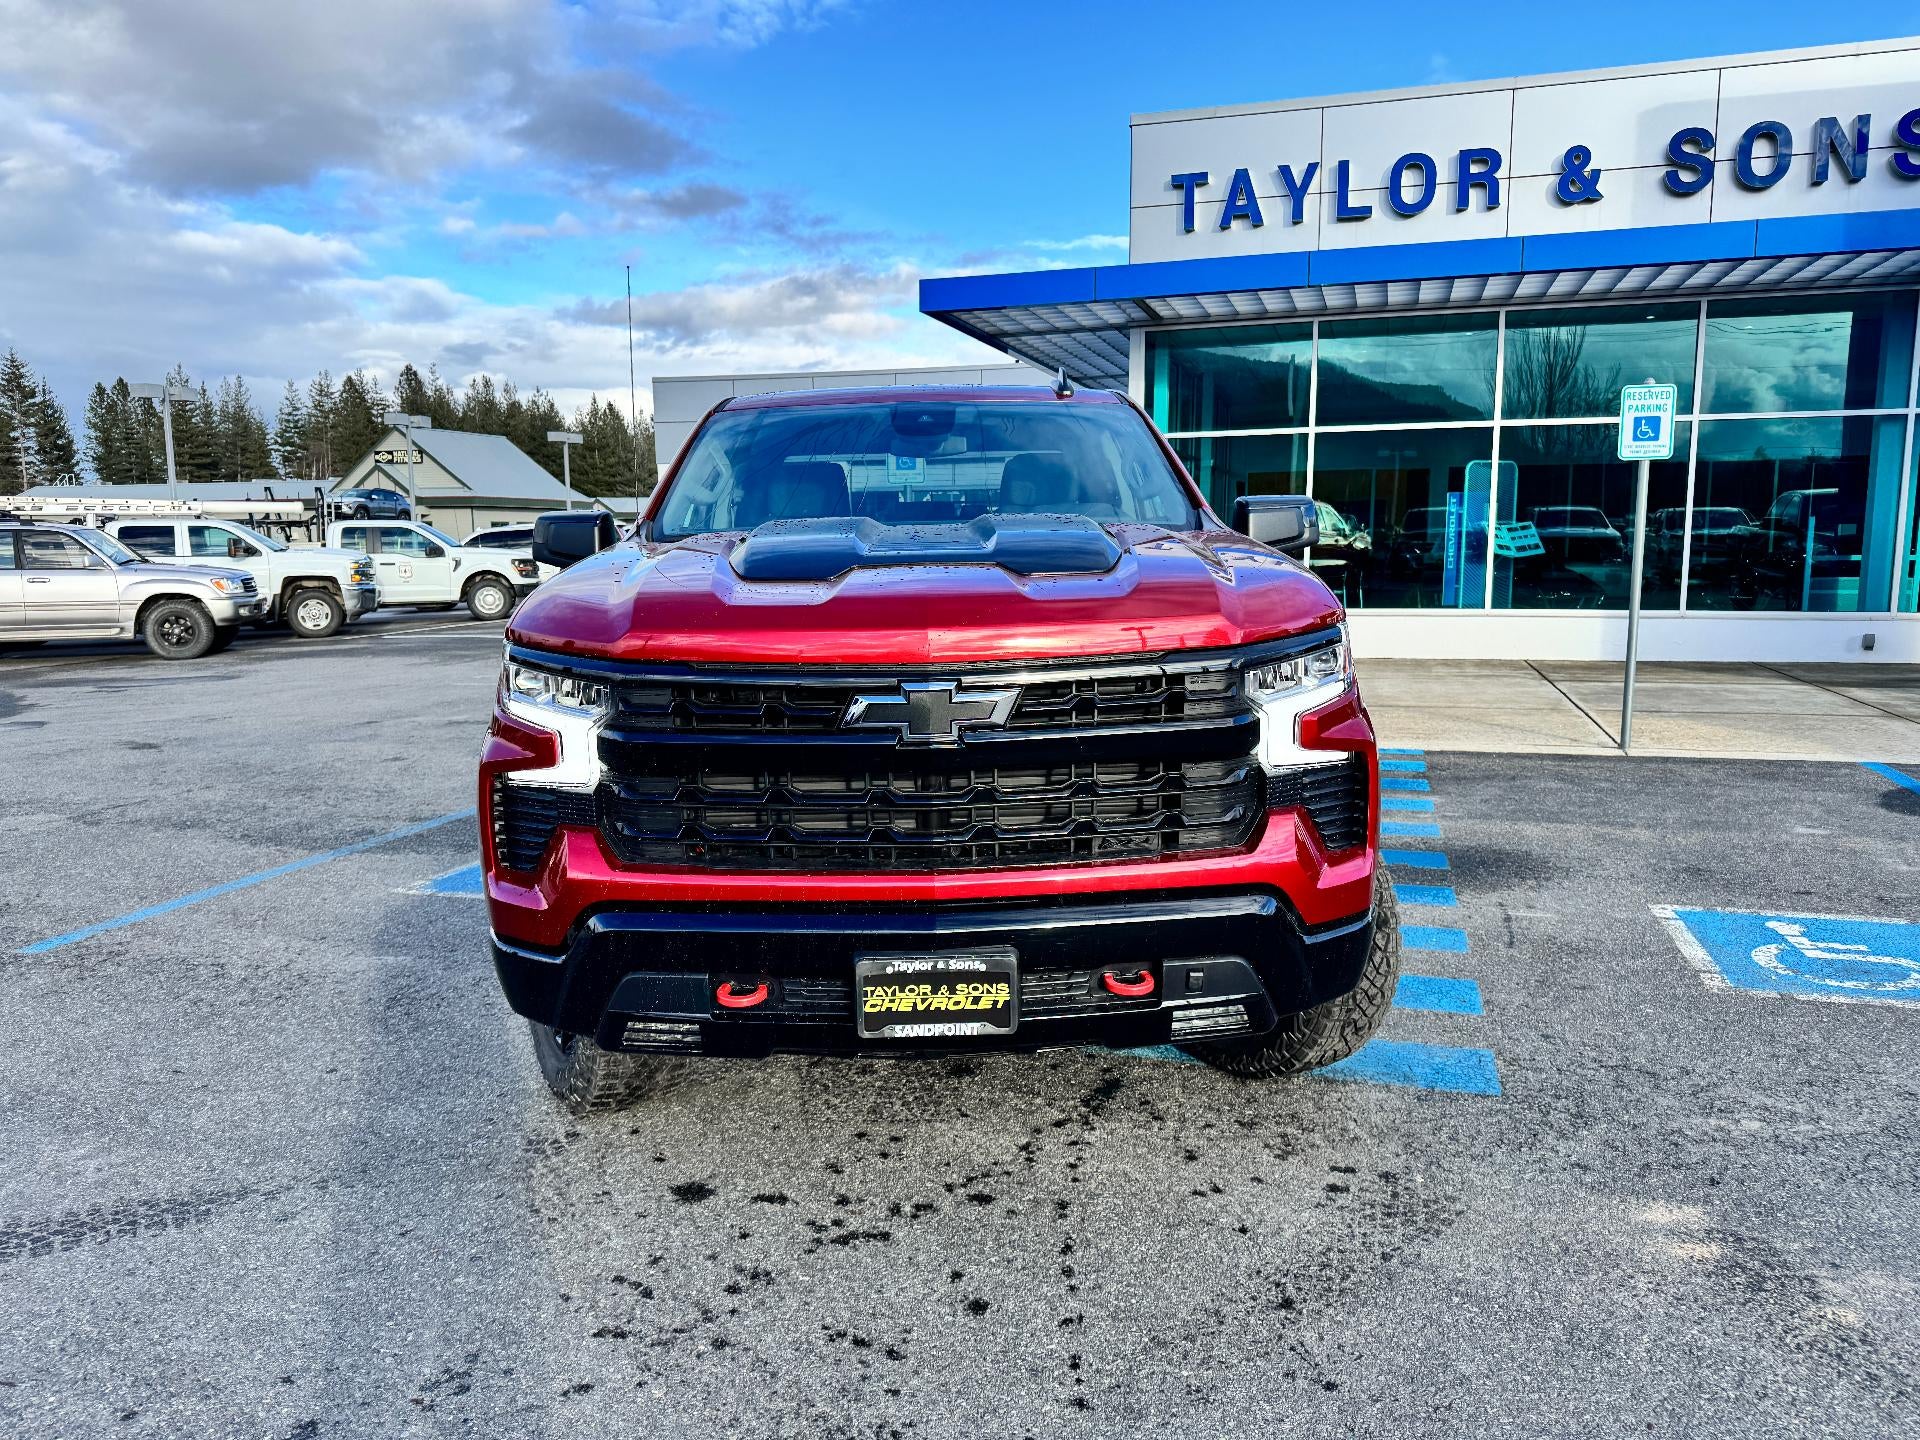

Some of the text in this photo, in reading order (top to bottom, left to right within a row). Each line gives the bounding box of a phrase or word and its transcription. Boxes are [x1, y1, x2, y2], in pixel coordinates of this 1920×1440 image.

[1171, 147, 1503, 232] TAYLOR
[1556, 144, 1604, 204] &
[1626, 390, 1671, 401] RESERVED
[1627, 403, 1668, 413] PARKING
[1447, 496, 1457, 569] CHEVROLET
[892, 960, 934, 973] Taylor
[949, 959, 980, 971] Sons
[863, 983, 1010, 998] TAYLOR & SONS
[864, 996, 1010, 1013] CHEVROLET
[894, 1023, 979, 1037] SANDPOINT
